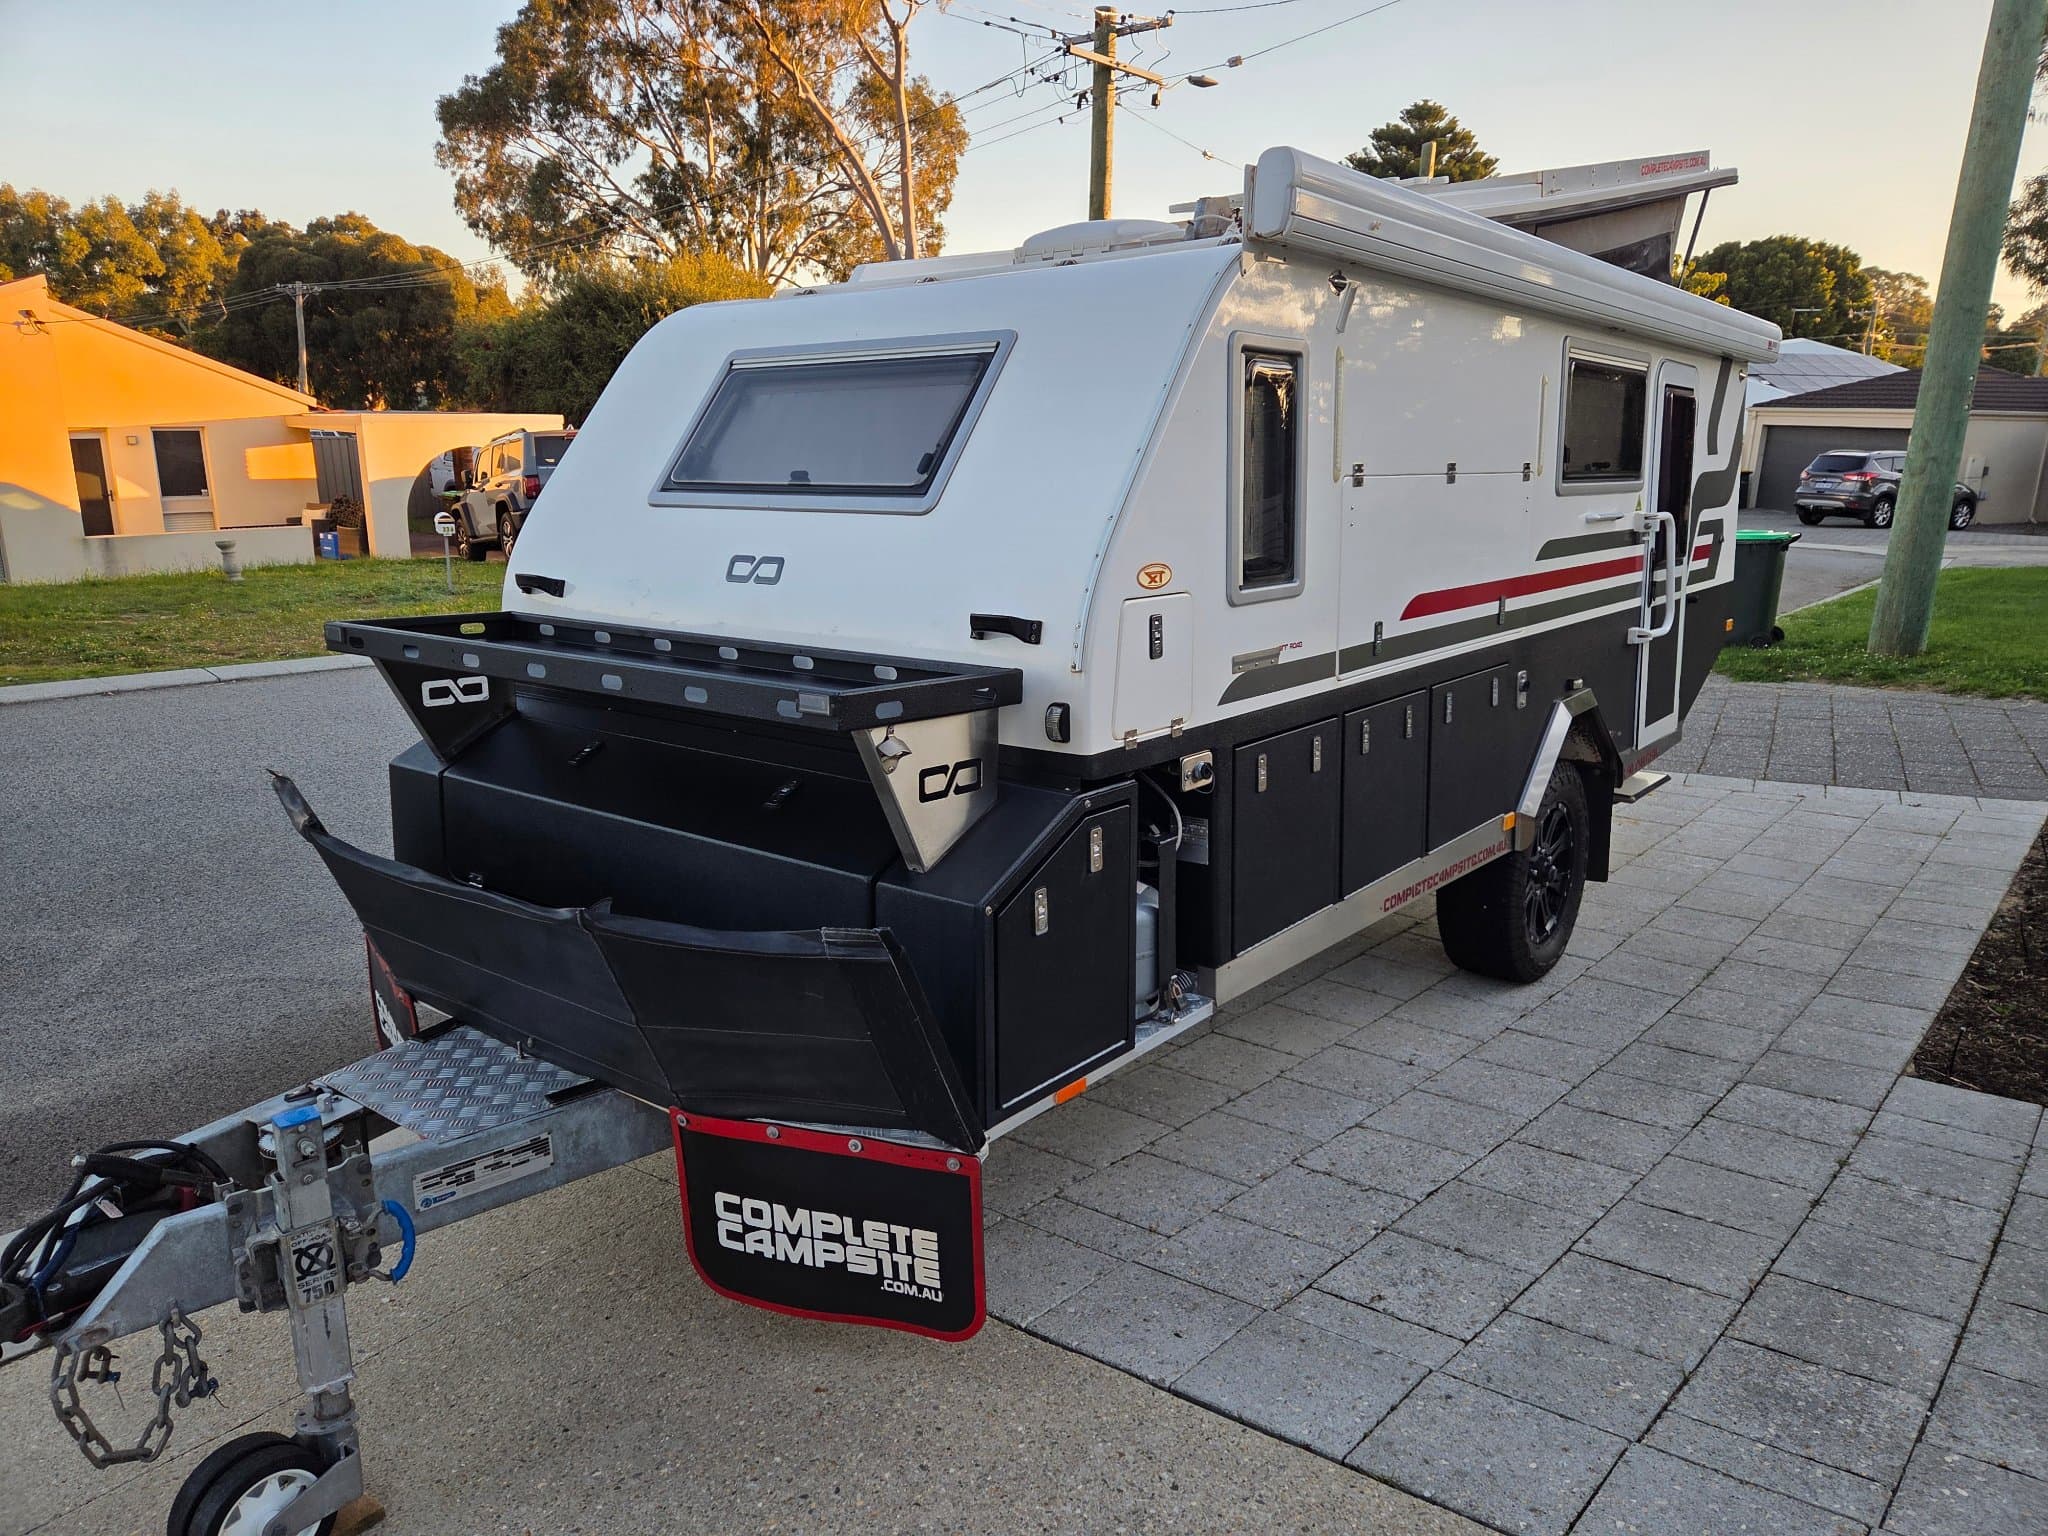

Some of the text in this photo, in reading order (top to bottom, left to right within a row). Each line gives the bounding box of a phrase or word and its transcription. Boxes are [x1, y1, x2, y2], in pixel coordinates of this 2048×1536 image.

[714, 1191, 939, 1259] COMPLETE
[717, 1220, 942, 1289] CAMPSITE
[297, 1269, 338, 1290] SERIES
[880, 1279, 943, 1303] .COM.AU
[303, 1280, 335, 1304] 750
